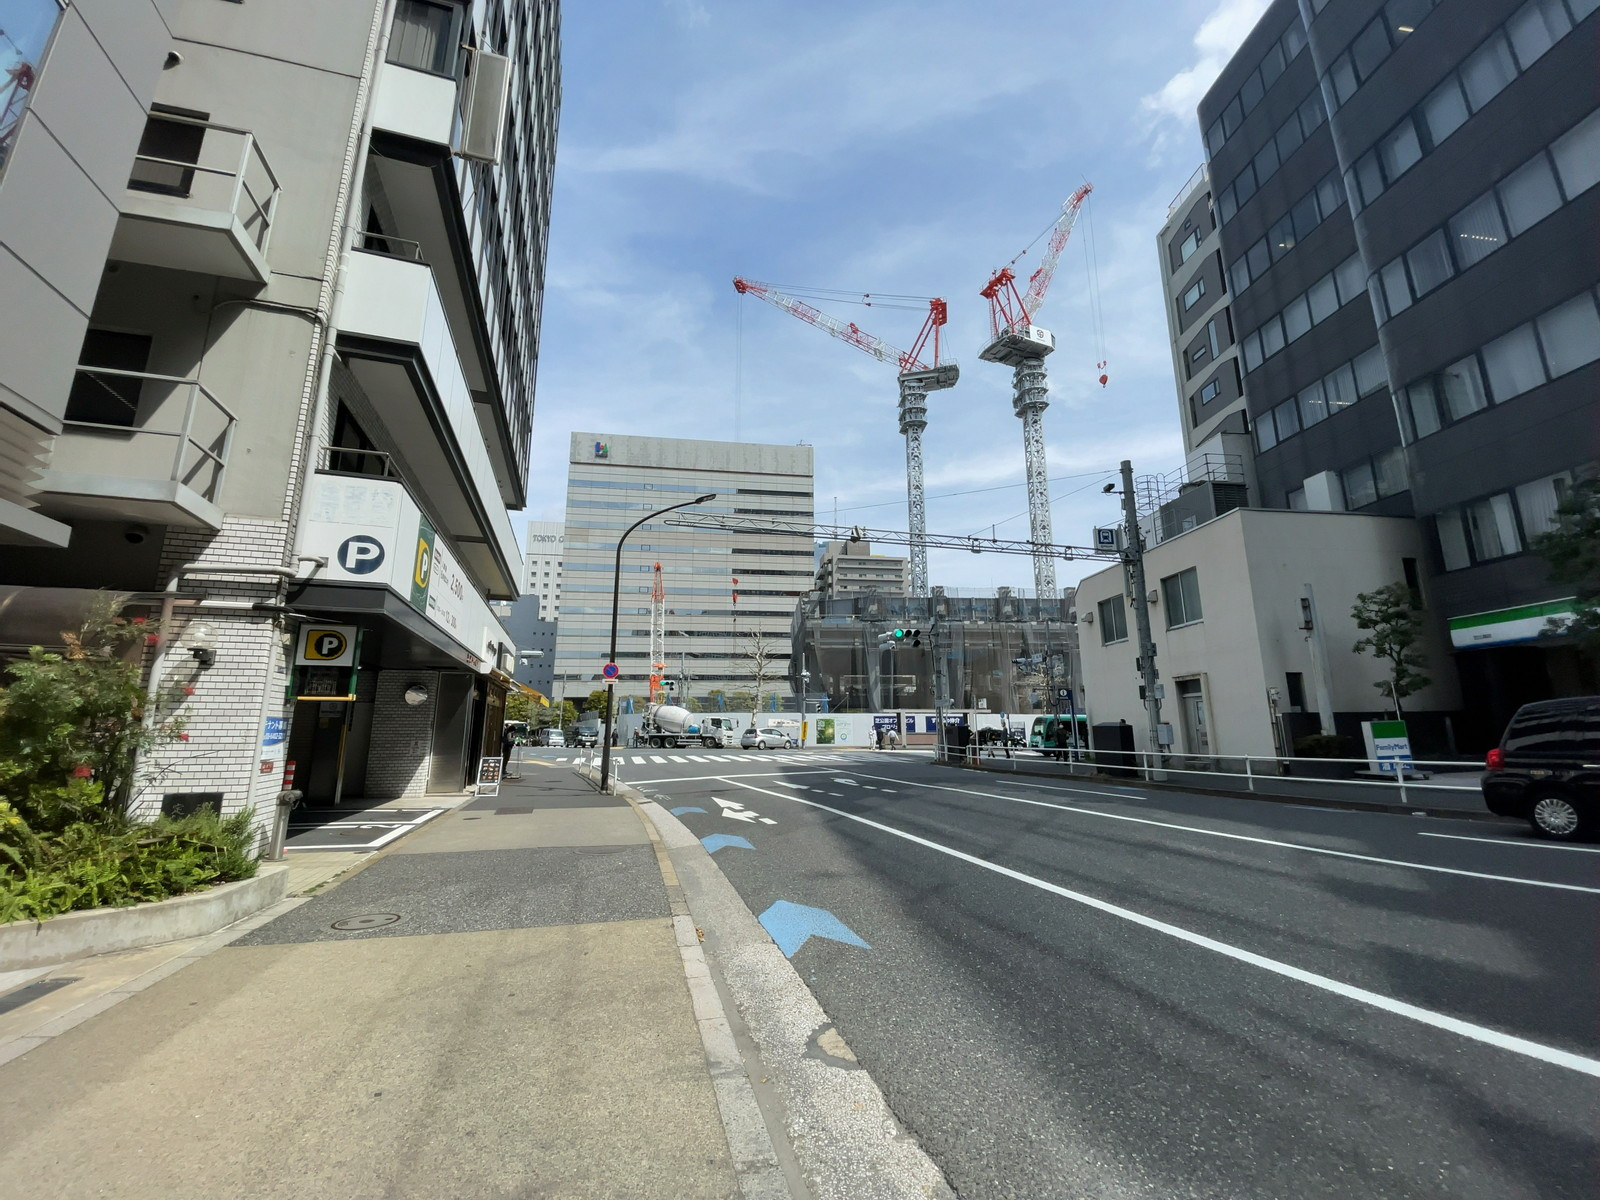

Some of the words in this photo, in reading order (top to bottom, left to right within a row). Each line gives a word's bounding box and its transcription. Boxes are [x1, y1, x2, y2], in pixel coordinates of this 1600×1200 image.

[532, 534, 557, 543] TOKYO
[345, 541, 381, 569] P
[321, 636, 339, 655] P
[1375, 743, 1409, 751] FamilyMart
